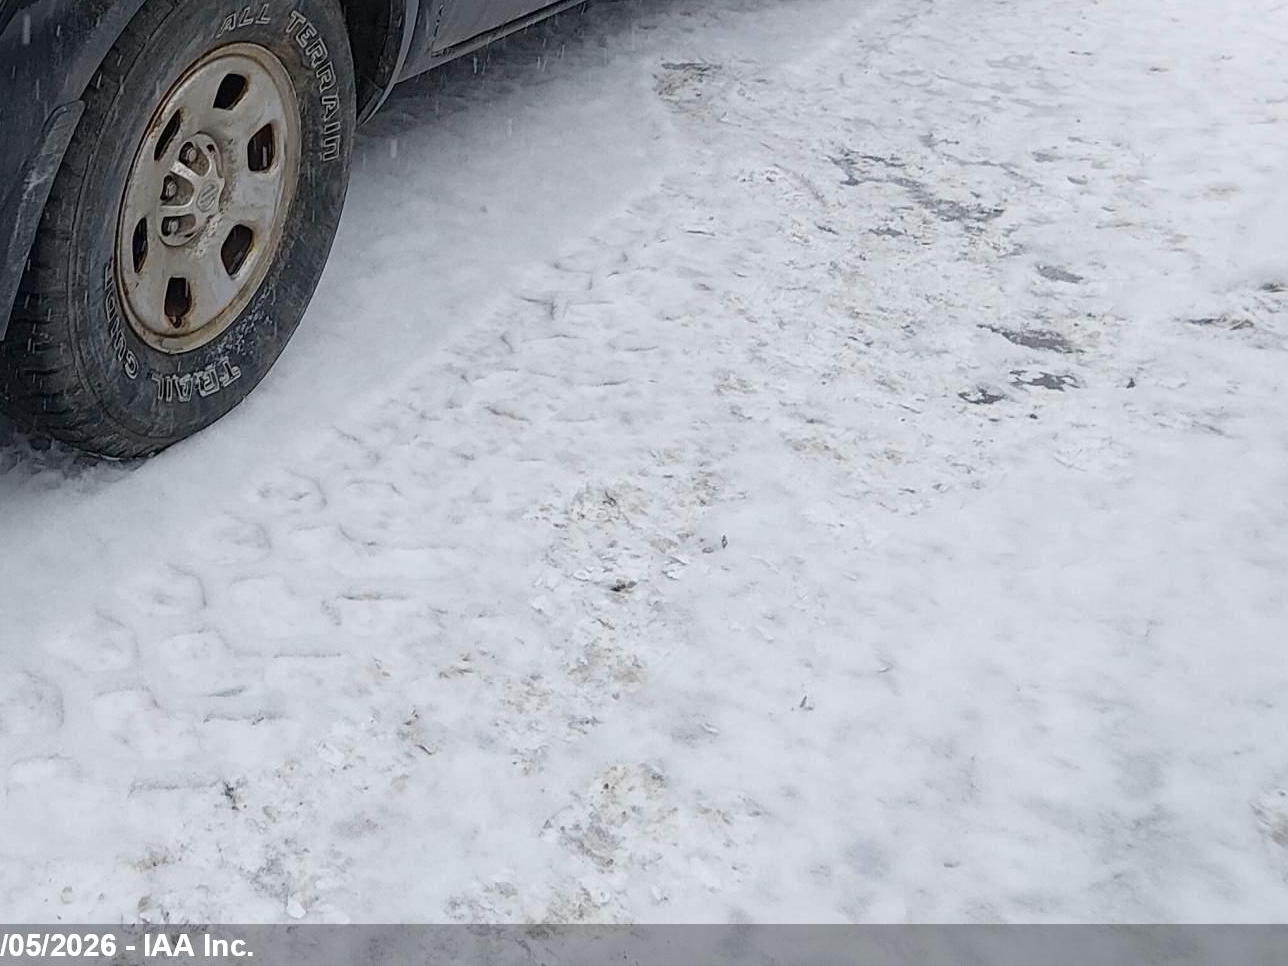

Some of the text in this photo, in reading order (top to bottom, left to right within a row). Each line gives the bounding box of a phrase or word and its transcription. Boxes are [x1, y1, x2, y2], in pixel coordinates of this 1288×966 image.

[215, 2, 342, 163] ALL TERRAIN
[150, 355, 242, 403] TRAIL
